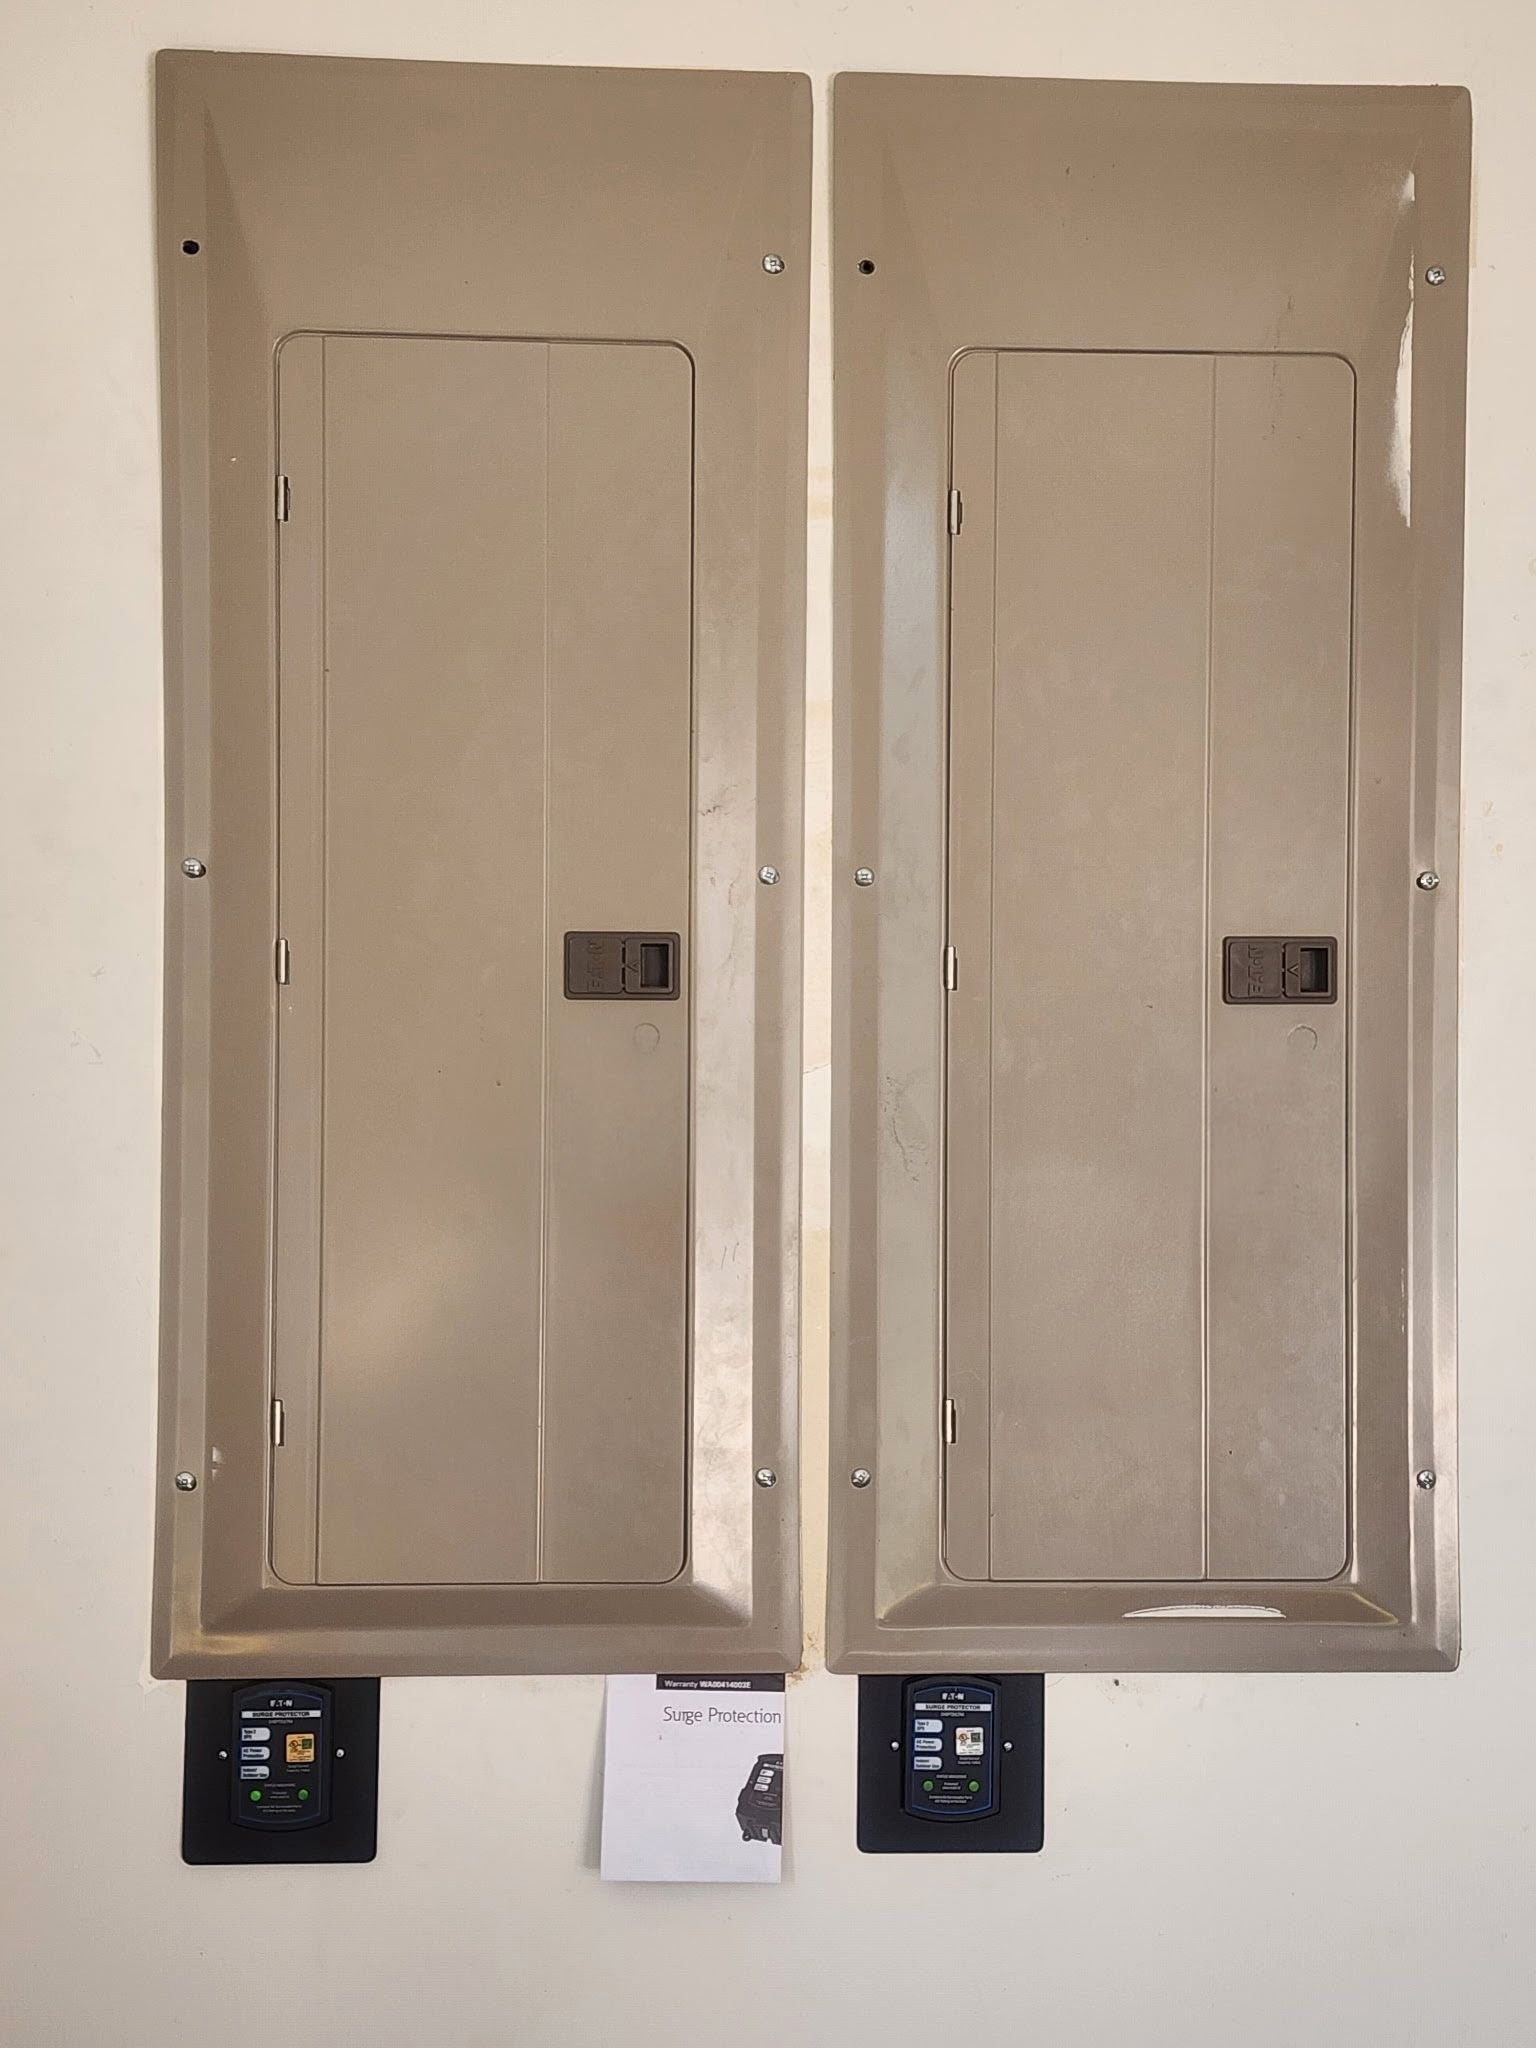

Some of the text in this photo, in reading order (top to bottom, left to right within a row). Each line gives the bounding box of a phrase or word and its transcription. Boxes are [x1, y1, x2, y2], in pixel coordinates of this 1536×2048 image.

[664, 1680, 698, 1688] Warranty
[663, 1706, 782, 1725] Surge Protection
